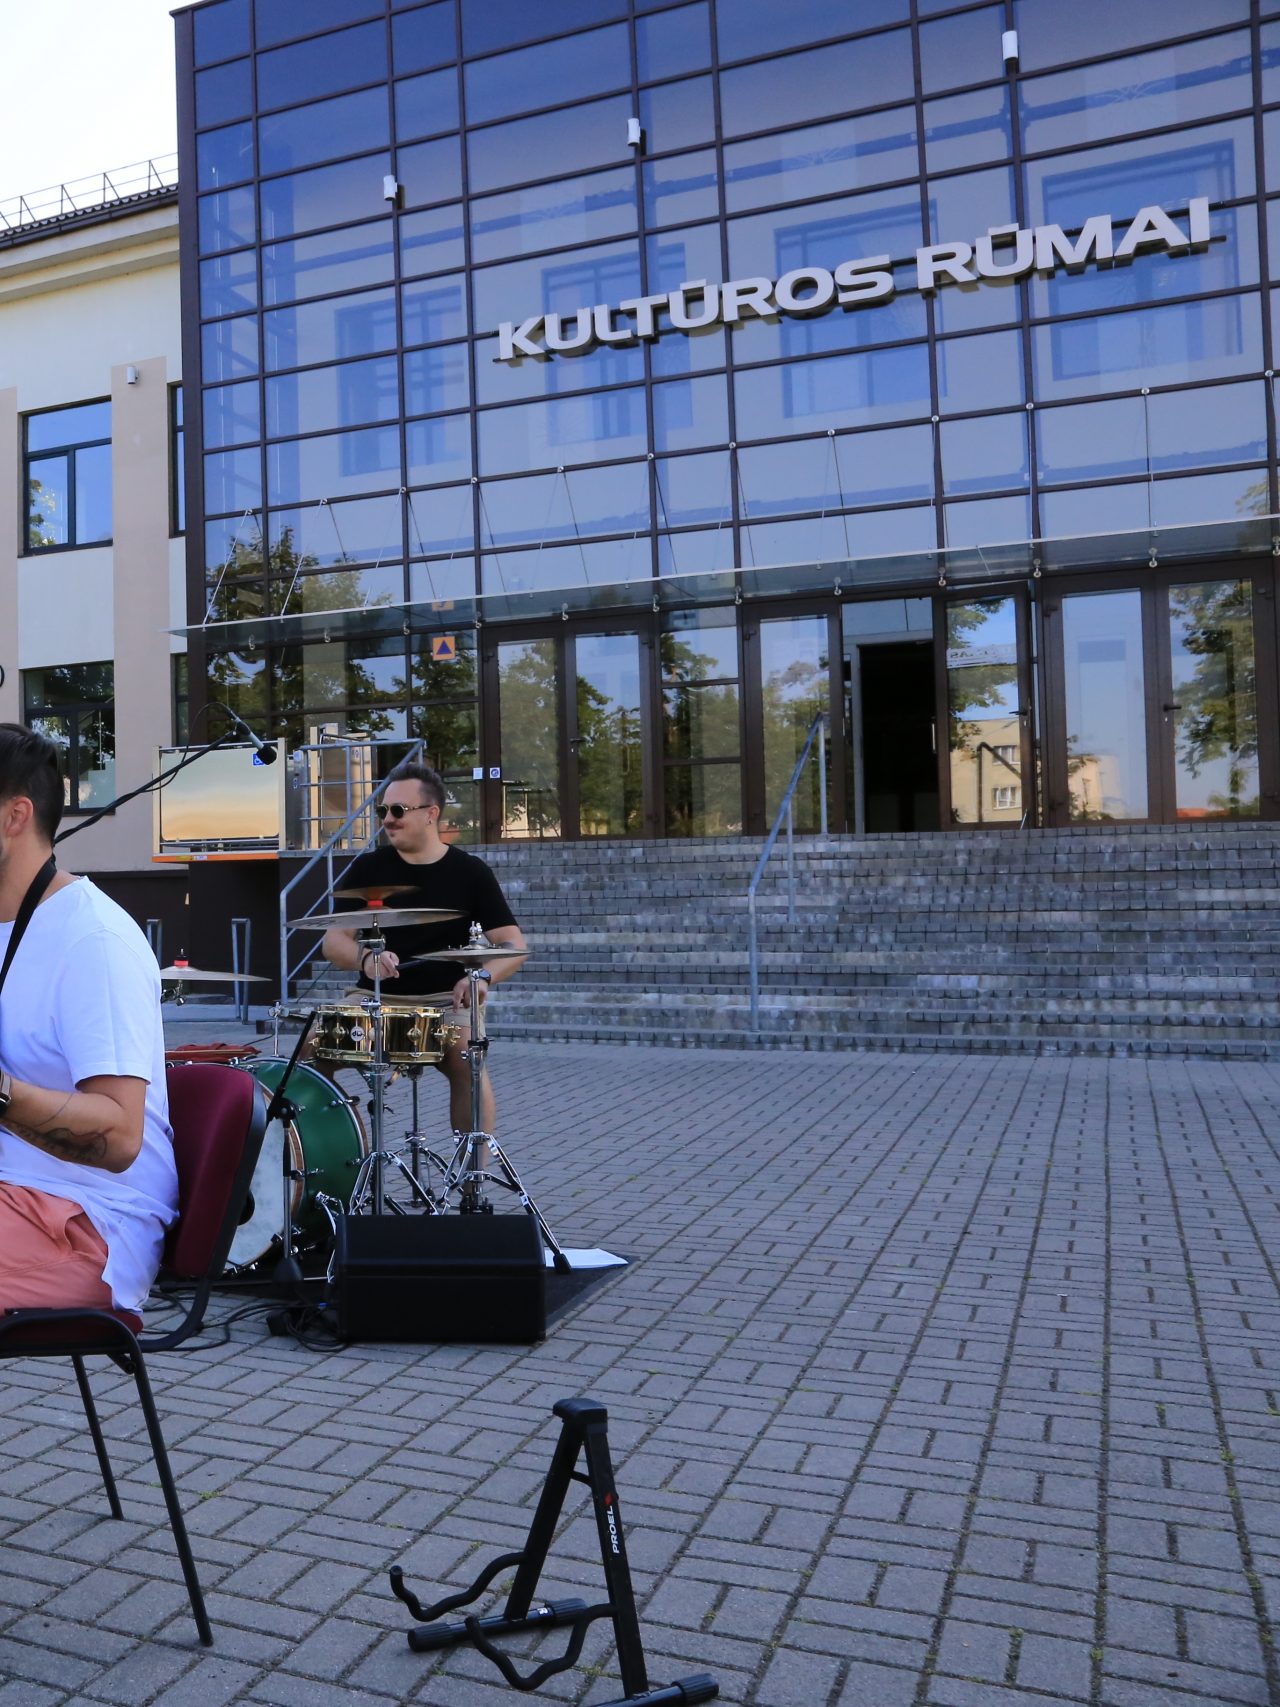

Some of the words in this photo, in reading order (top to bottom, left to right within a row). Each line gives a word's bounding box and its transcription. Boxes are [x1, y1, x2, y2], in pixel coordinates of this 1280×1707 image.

[498, 255, 894, 360] KULTŪROS
[916, 197, 1210, 290] RŪMAI
[607, 1505, 620, 1553] PROEL
